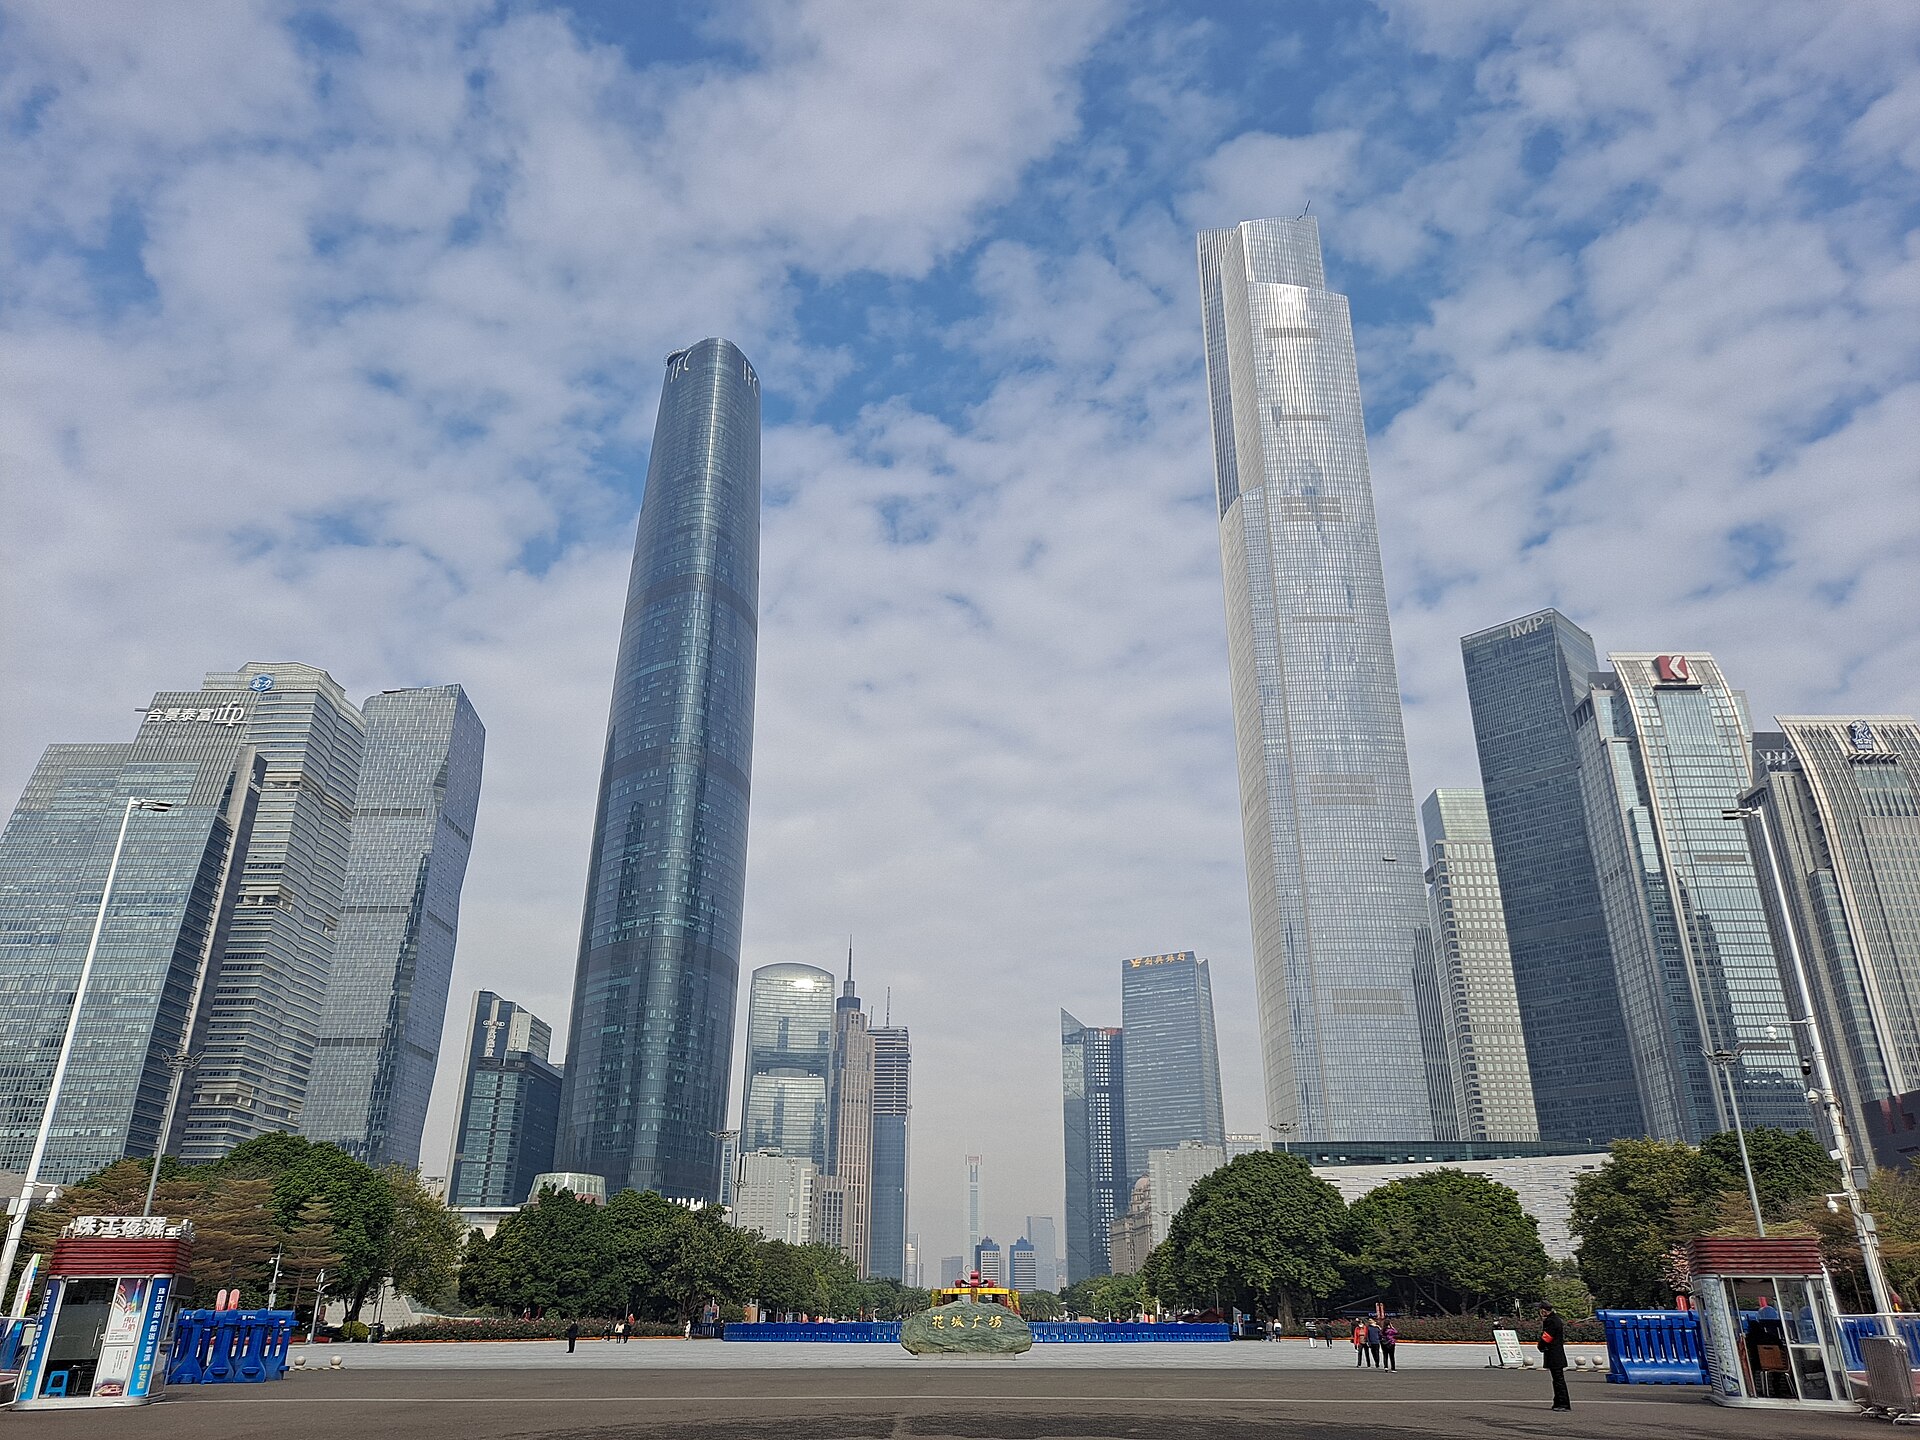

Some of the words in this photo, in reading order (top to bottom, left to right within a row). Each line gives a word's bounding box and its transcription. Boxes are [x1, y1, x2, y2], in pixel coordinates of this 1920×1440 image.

[1509, 616, 1545, 639] IMP
[147, 707, 215, 722] 合景泰富
[73, 1215, 167, 1237] 珠江夜游
[931, 1314, 1003, 1329] 花城广场
